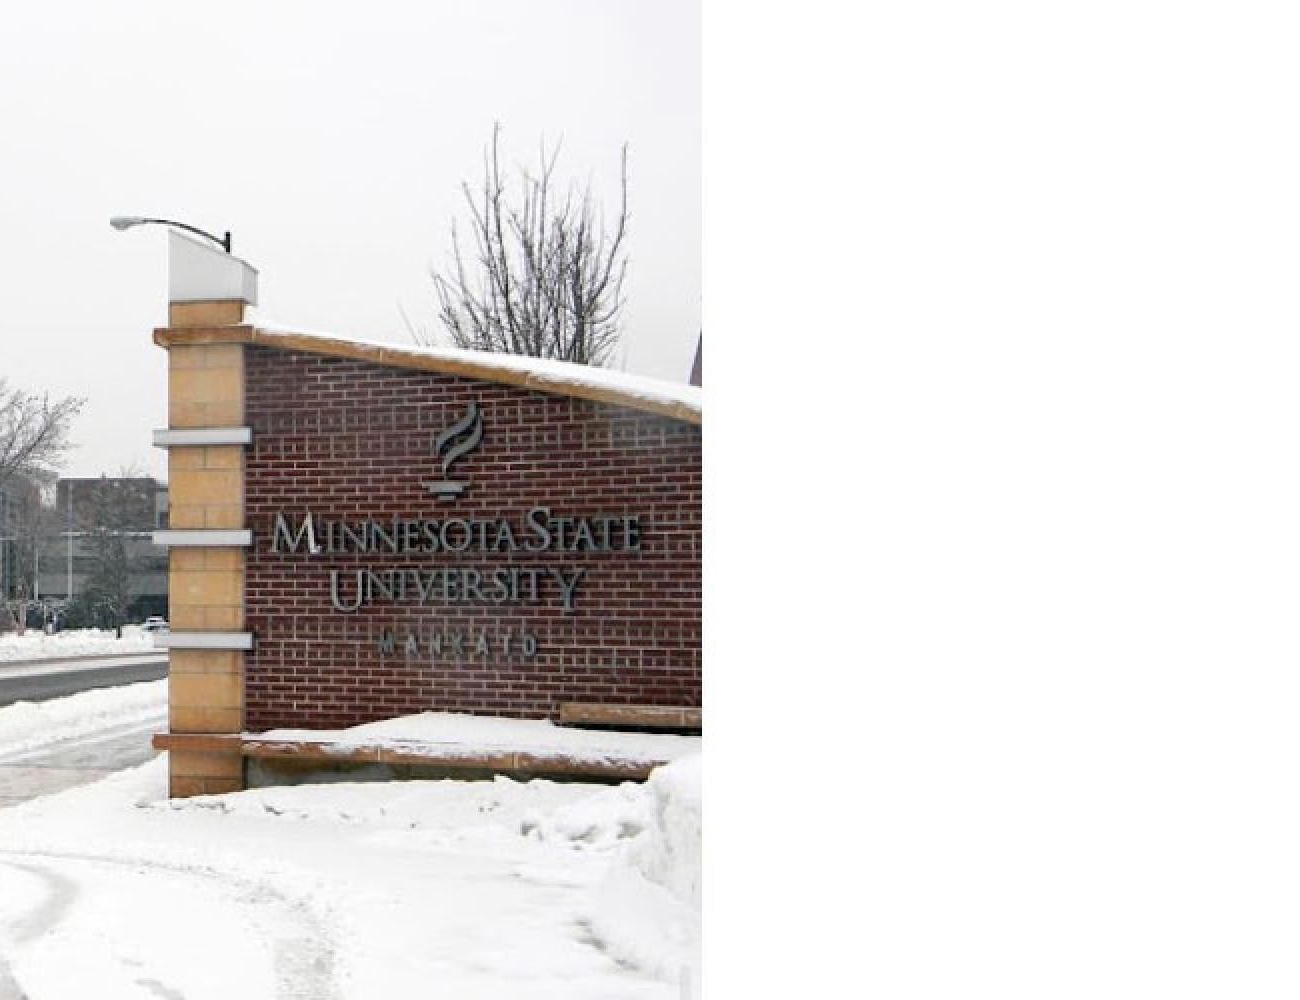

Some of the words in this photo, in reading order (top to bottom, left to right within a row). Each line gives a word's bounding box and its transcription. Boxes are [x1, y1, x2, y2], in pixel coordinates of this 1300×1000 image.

[271, 511, 523, 553] MINNESOTA
[524, 507, 641, 552] STATE
[328, 568, 588, 613] UNIVERSITY
[379, 632, 539, 657] MANKATO
